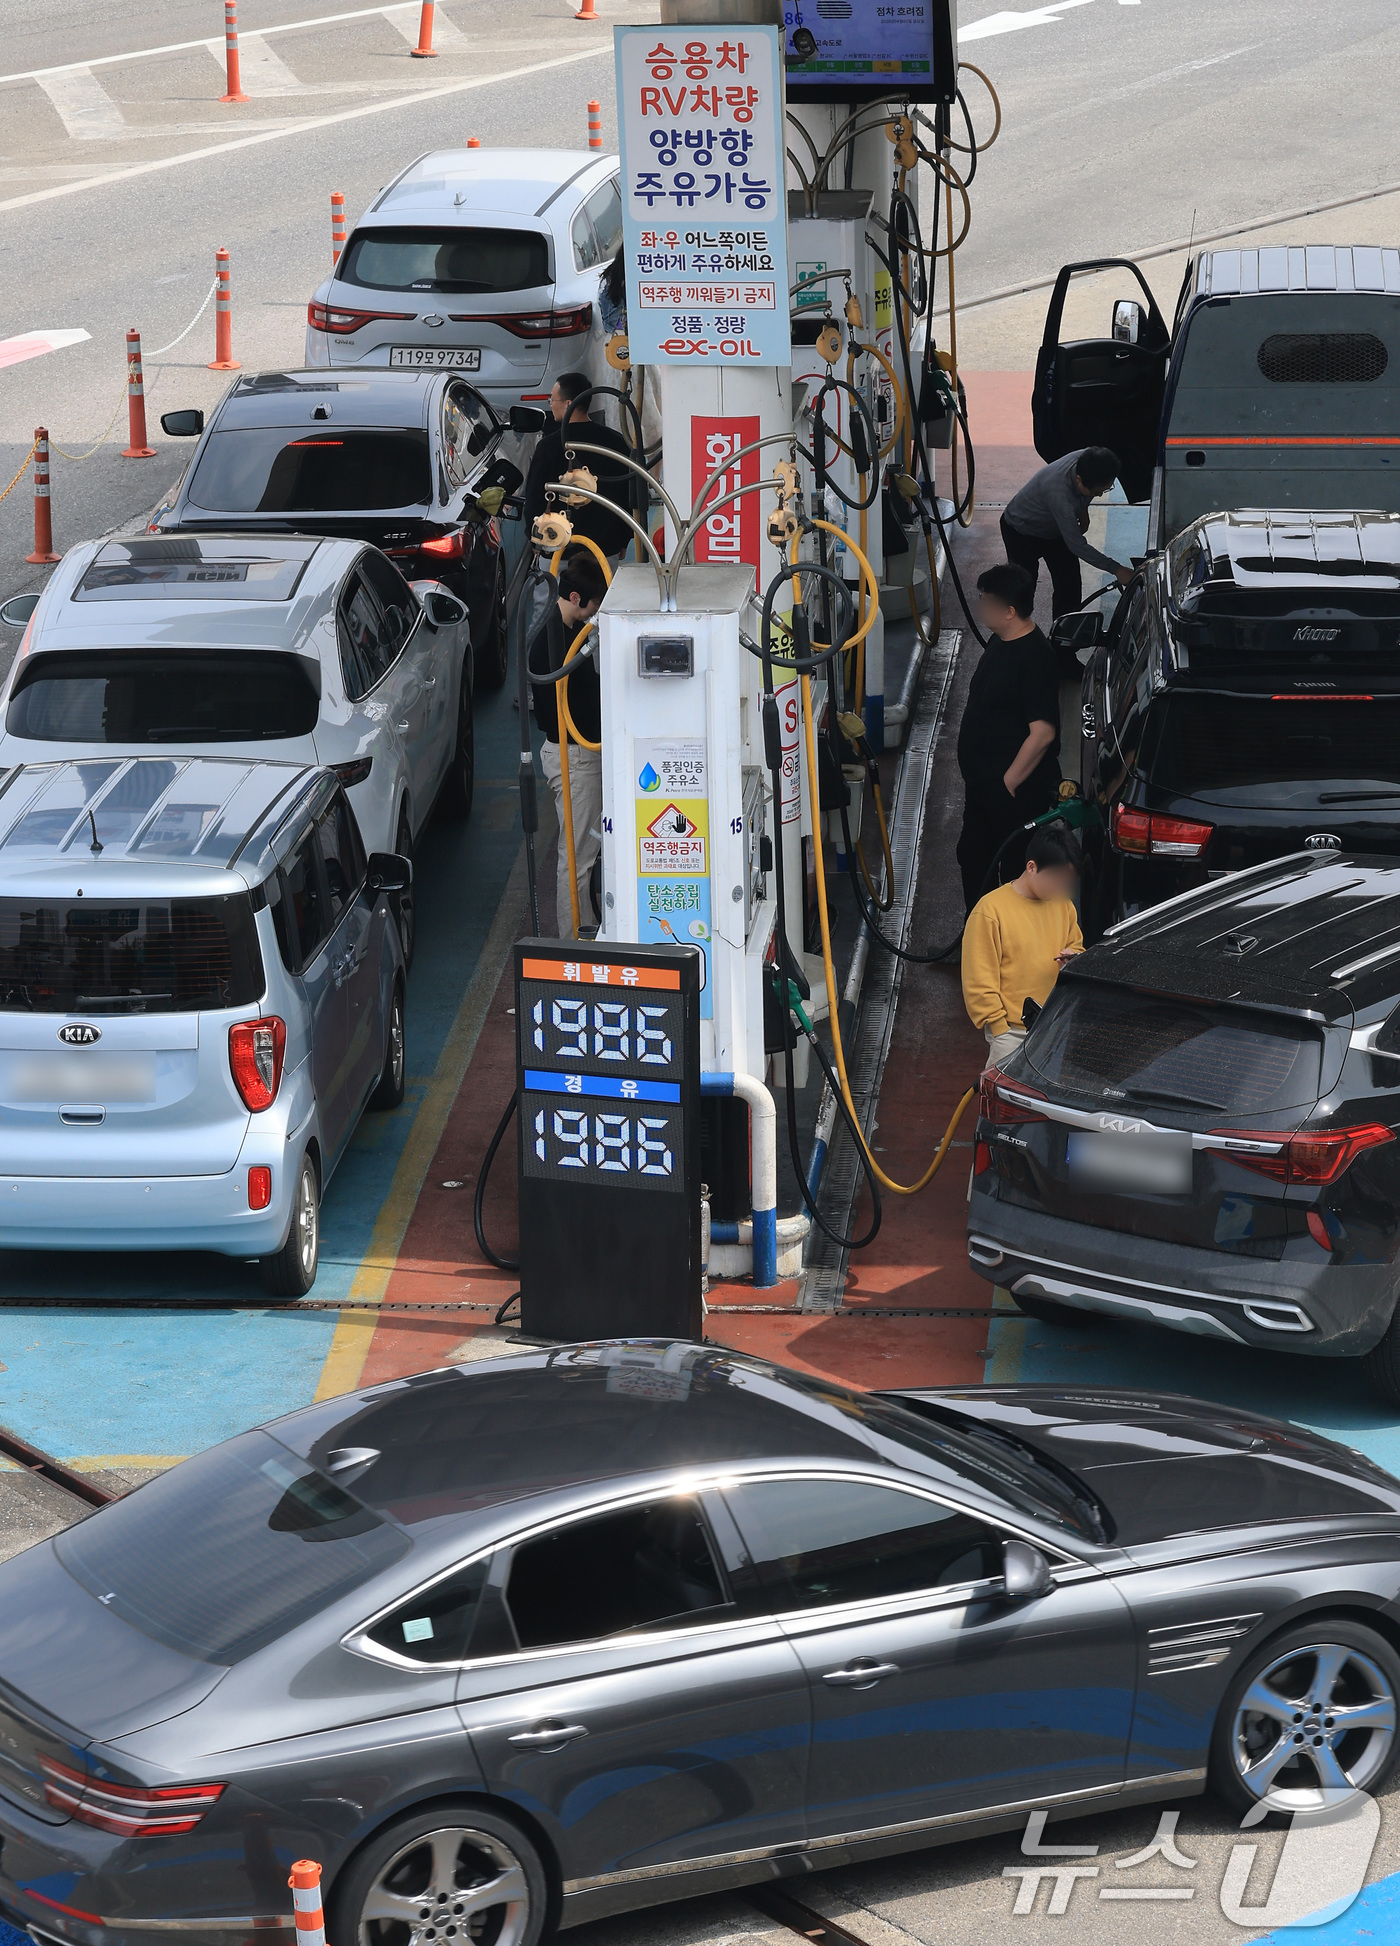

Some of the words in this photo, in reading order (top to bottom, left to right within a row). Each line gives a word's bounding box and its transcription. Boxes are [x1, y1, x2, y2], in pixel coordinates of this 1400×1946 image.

[876, 6, 895, 17] 점차
[897, 6, 924, 17] 흐려짐
[644, 41, 750, 80] 승용차
[640, 85, 759, 123] RV차량
[649, 128, 754, 167] 양방향
[633, 171, 772, 210] 주유가능
[684, 231, 769, 252] 어느쪽이든
[636, 253, 687, 273] 편하게
[690, 253, 775, 272] 주유하세요
[641, 286, 683, 304] 역주행
[685, 286, 740, 303] 끼워들기
[743, 286, 772, 302] 금지
[875, 287, 893, 312] 주유
[397, 349, 434, 365] 119모
[437, 350, 474, 366] 9734
[705, 432, 742, 564] 화기엄
[661, 761, 704, 774] 품질인증
[666, 774, 700, 787] 주유소
[602, 816, 614, 834] 14
[729, 816, 743, 835] 15
[643, 841, 702, 856] 역주행금지
[647, 884, 700, 898] 탄소중립
[648, 898, 700, 912] 실천하기
[64, 1028, 95, 1041] KIA
[533, 999, 672, 1065] 1986
[535, 1109, 673, 1176] 1986
[997, 1132, 1028, 1148] SELTOS
